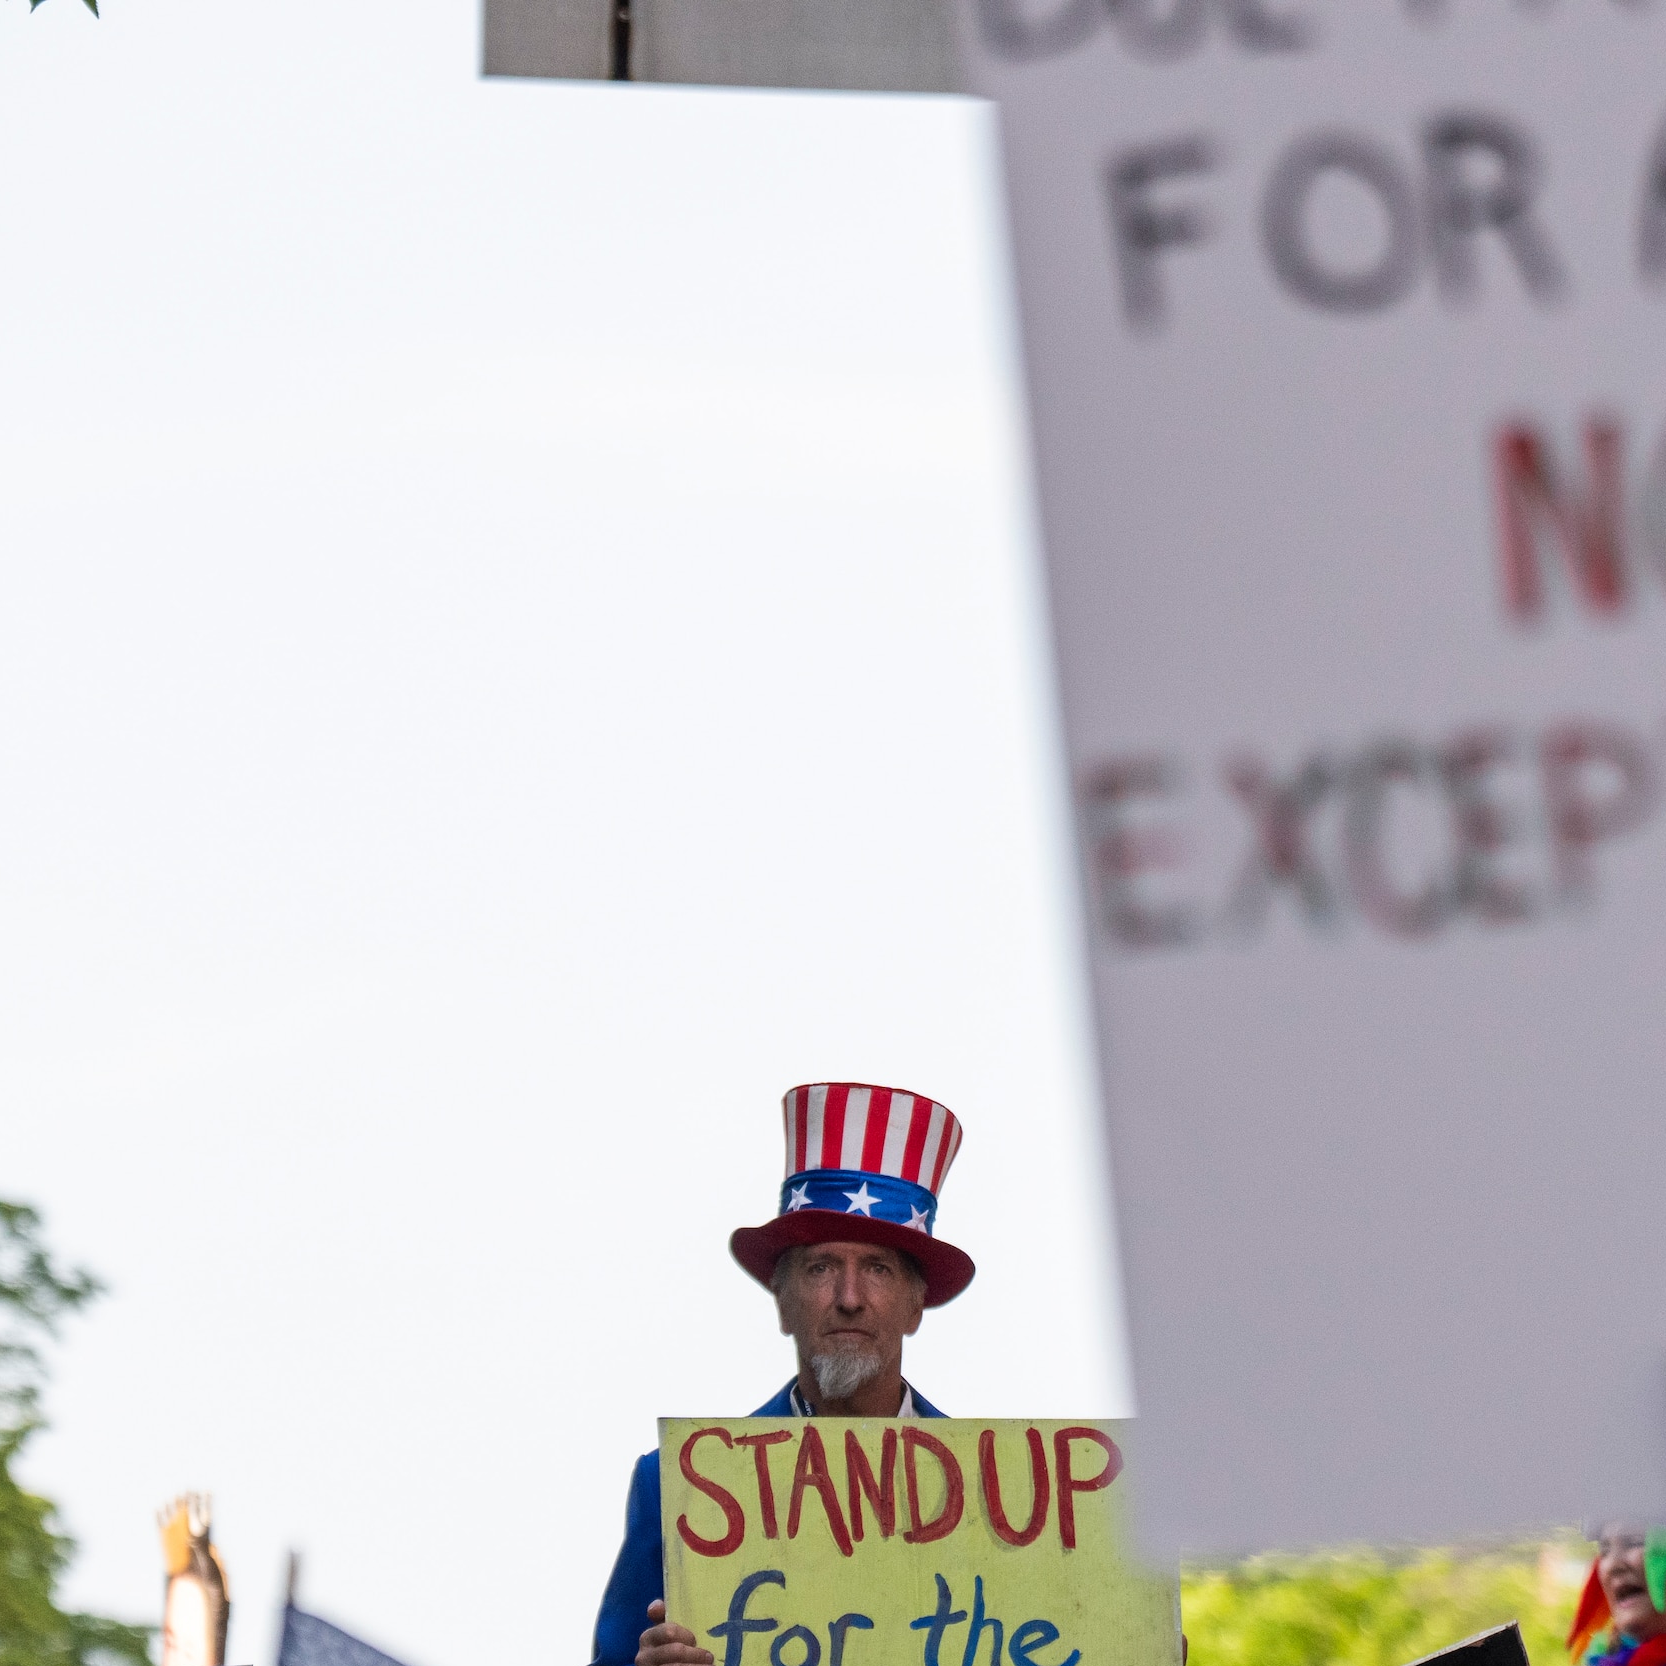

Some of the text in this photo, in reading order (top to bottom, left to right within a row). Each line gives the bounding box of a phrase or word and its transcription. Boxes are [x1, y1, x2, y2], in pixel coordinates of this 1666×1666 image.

[1101, 108, 1569, 334] FOR
[675, 1422, 1126, 1559] STAND UP
